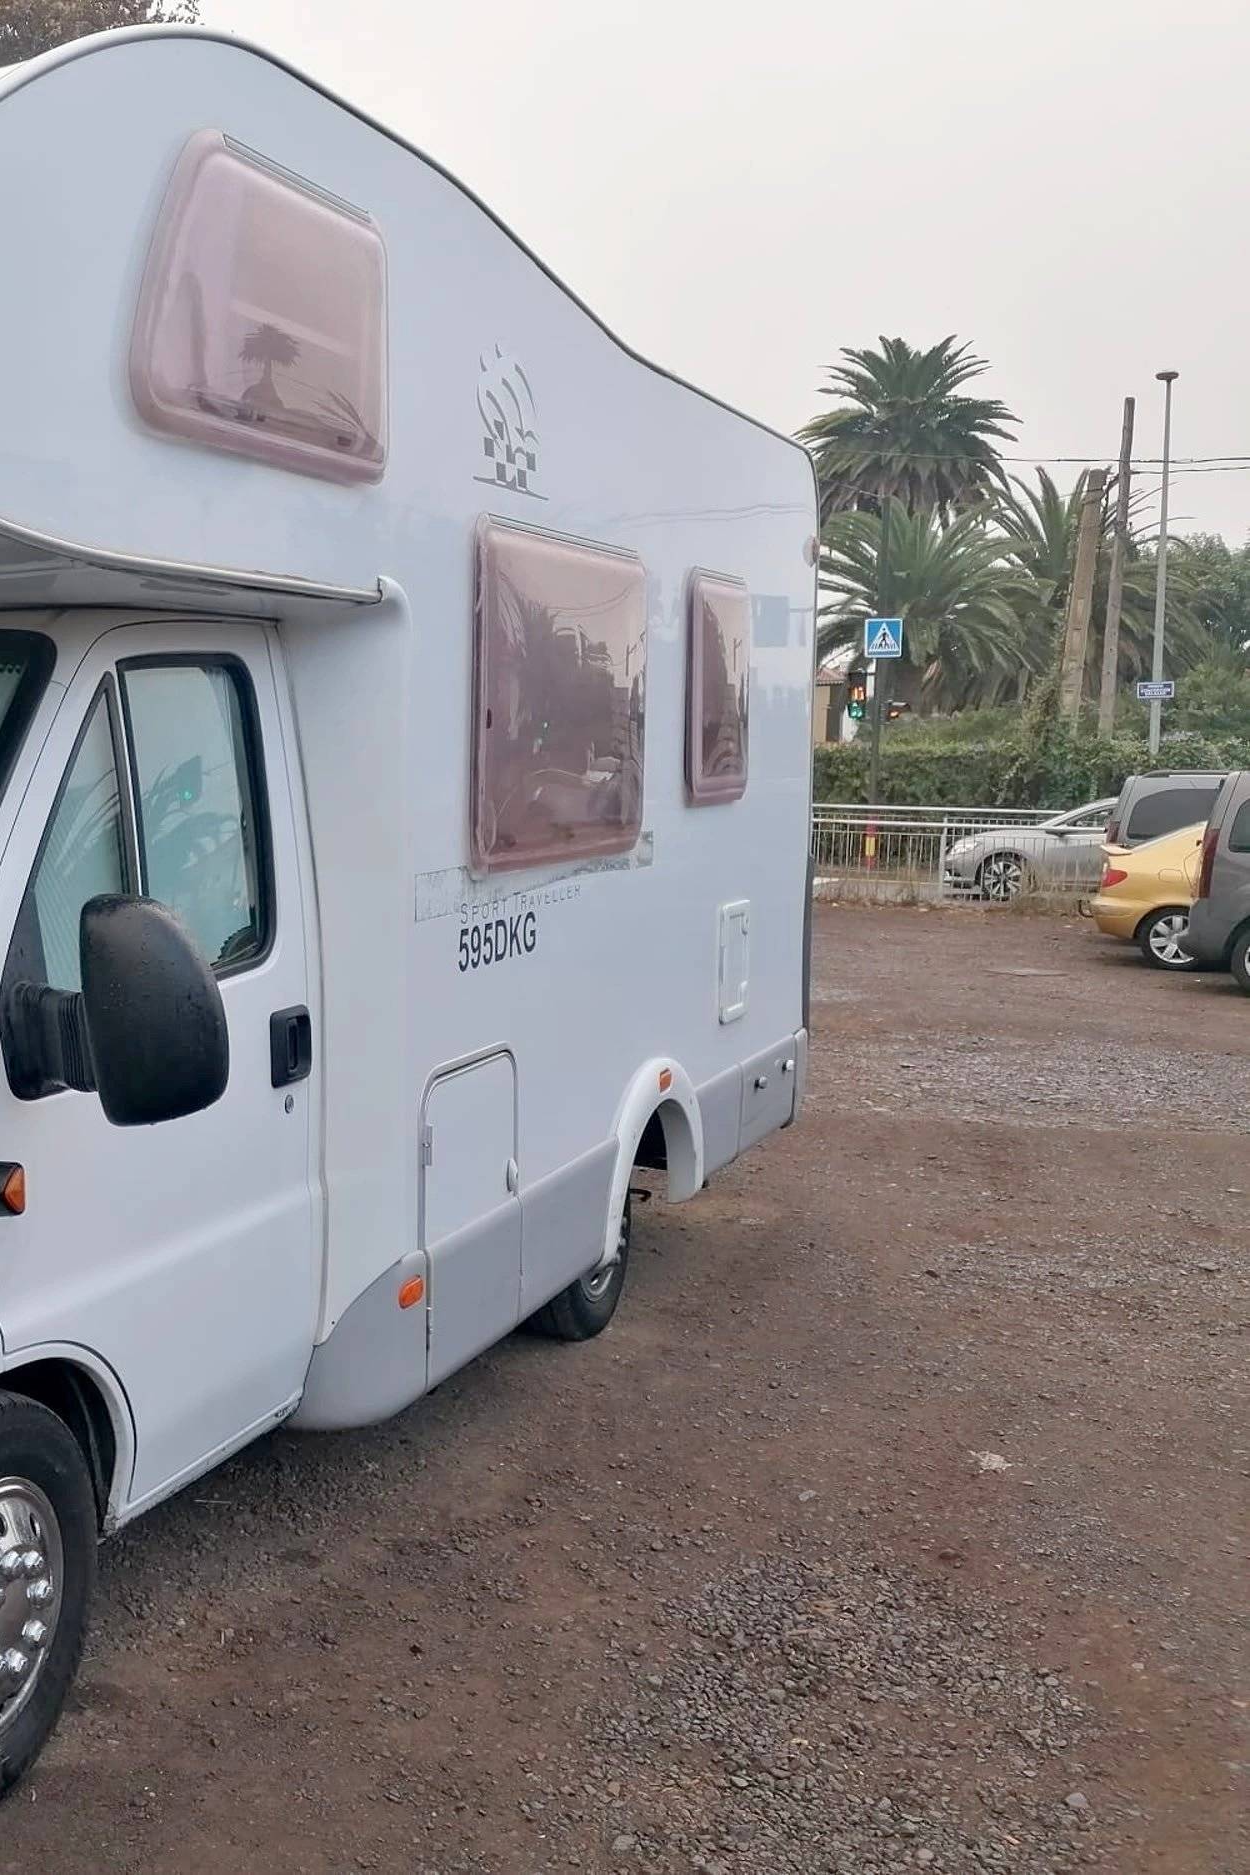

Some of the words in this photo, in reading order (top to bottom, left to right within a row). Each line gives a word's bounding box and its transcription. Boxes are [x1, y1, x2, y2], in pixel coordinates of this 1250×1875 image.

[461, 899, 507, 925] SPORT
[513, 884, 581, 911] TRAVELLER
[458, 912, 536, 972] 595DKG
